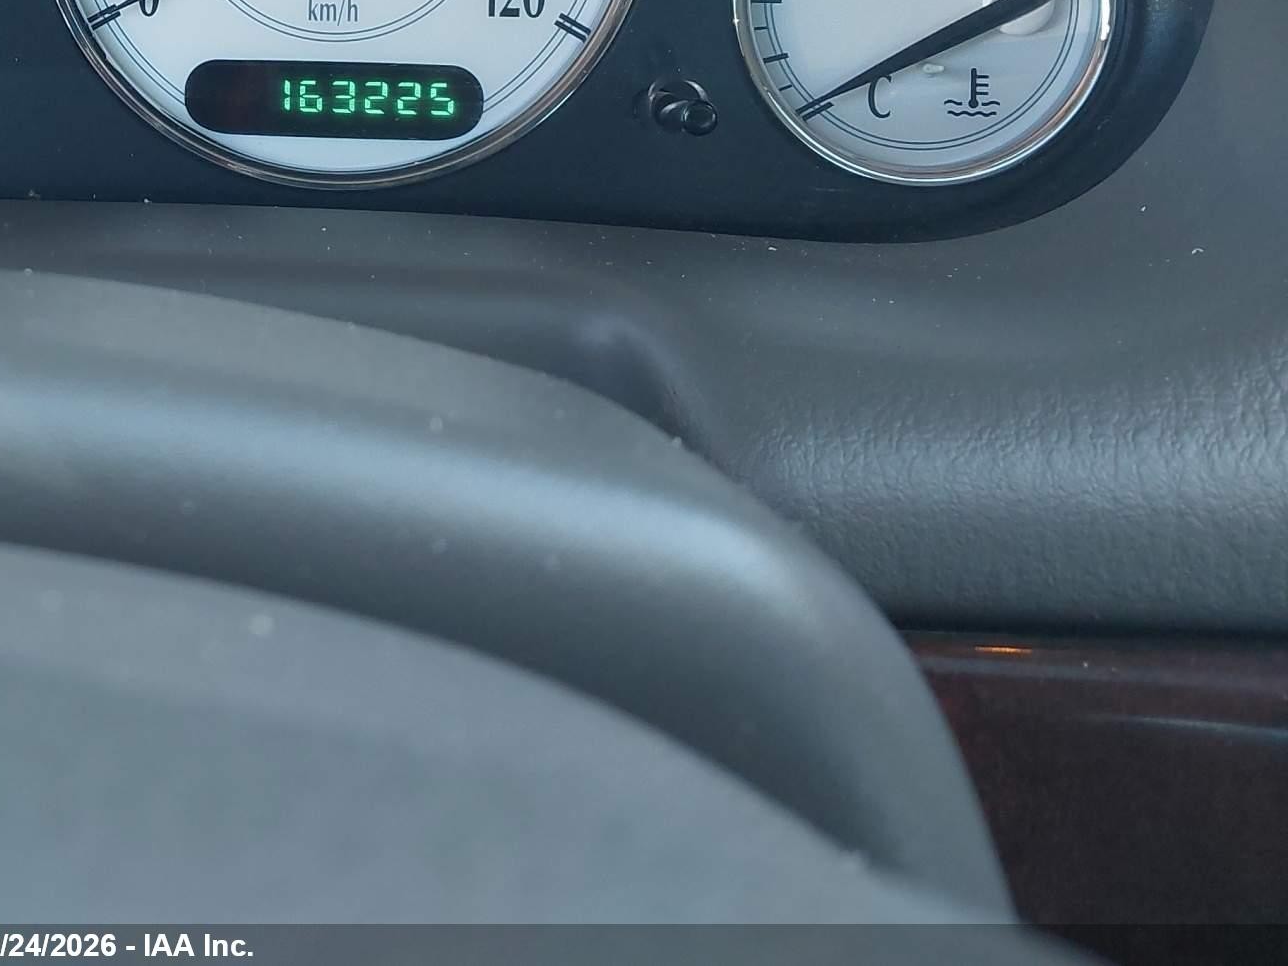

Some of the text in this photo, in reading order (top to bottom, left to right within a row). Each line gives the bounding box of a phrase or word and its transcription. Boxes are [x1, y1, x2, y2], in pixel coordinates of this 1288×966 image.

[307, 0, 359, 25] km/h
[283, 79, 456, 116] 163225
[867, 75, 891, 118] C
